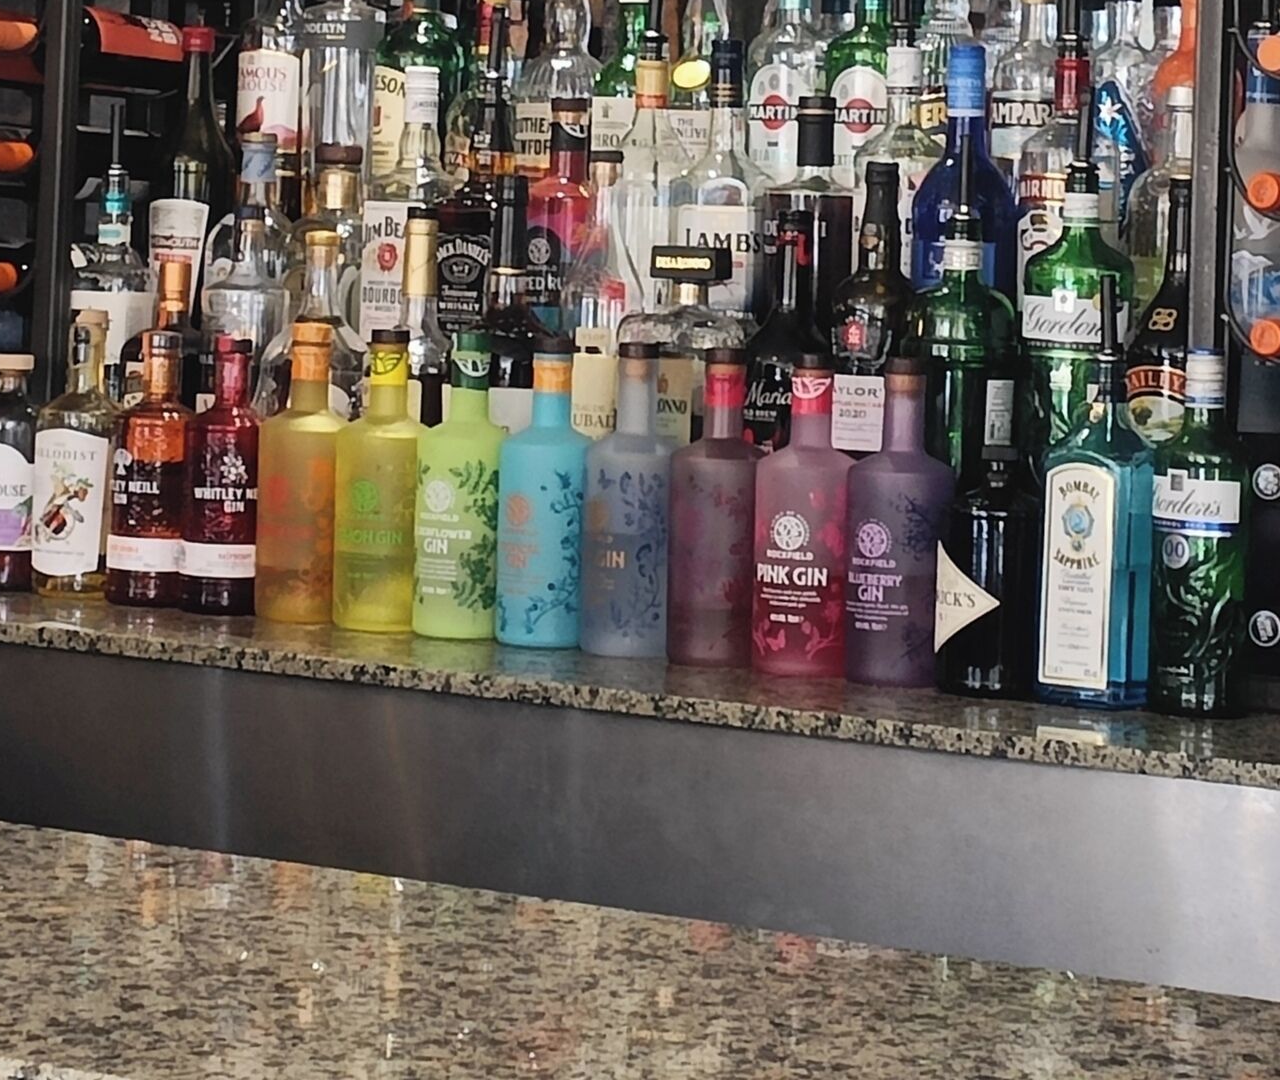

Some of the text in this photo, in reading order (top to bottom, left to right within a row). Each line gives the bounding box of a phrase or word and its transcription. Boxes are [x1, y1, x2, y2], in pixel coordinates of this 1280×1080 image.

[193, 487, 243, 500] WHITLEY
[1058, 480, 1101, 503] BOMBAY
[223, 501, 245, 513] GIN
[423, 538, 448, 554] GIN
[1052, 548, 1101, 570] SAPPHIRE
[757, 562, 828, 587] PINK GIN
[847, 571, 903, 588] BLUEBERRY
[857, 586, 884, 602] GIN
